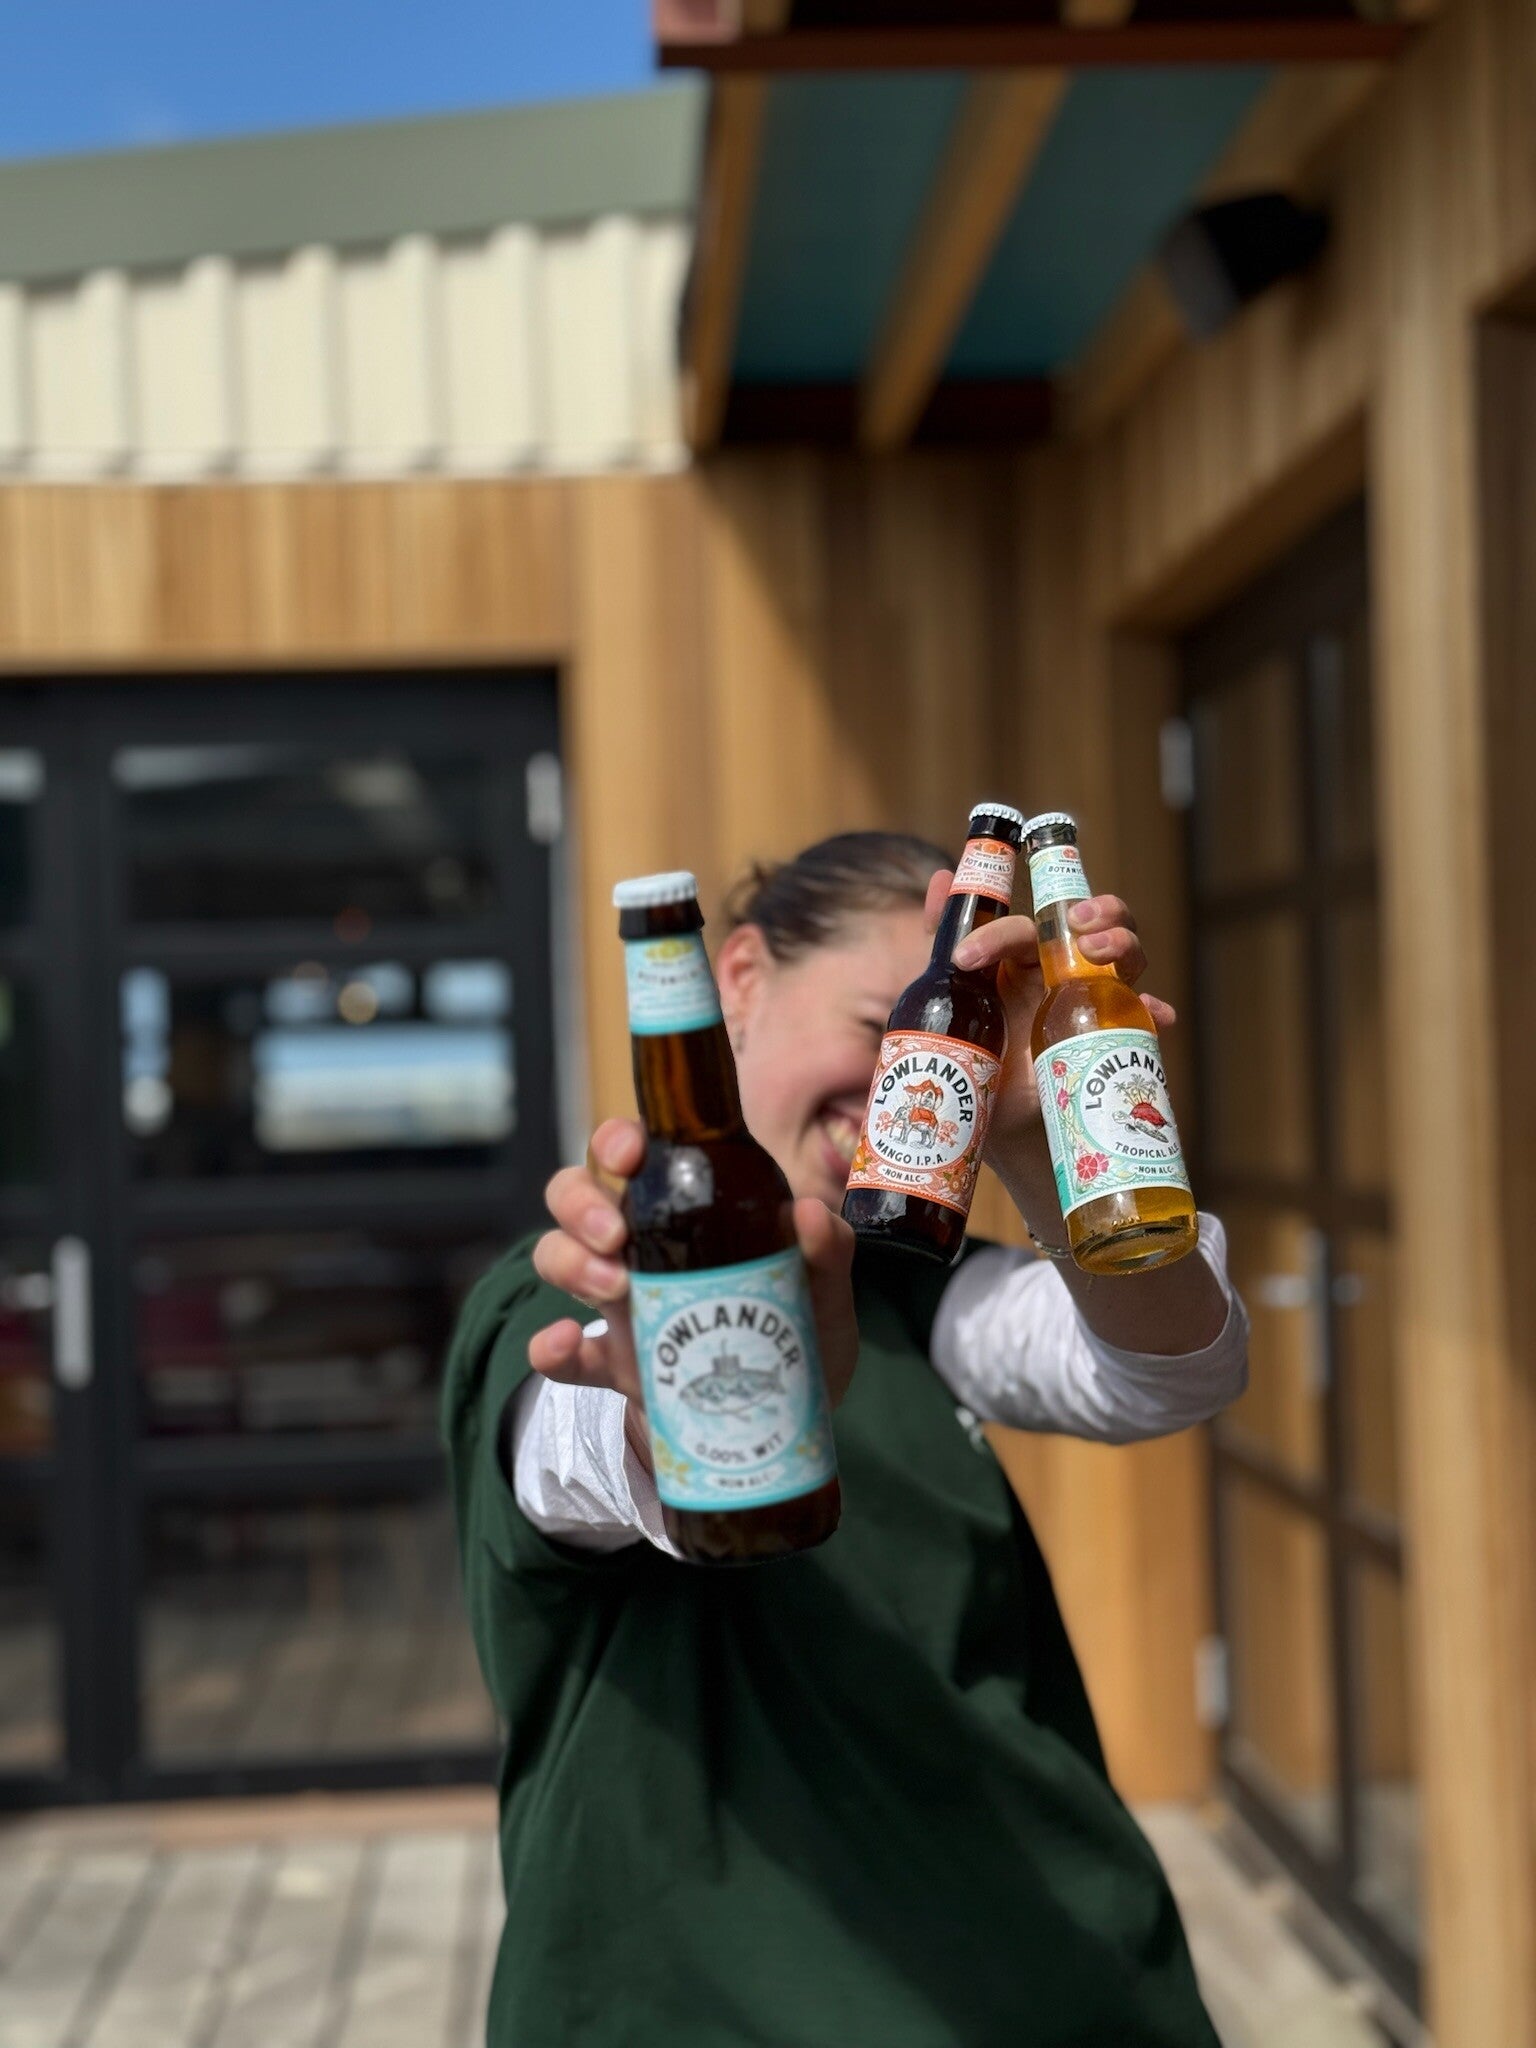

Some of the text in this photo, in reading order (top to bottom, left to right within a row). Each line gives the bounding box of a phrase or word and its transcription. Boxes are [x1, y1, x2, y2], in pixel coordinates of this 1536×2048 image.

[1085, 1051, 1167, 1110] LOWLAND
[875, 1139, 948, 1166] MANGO I.P.A.
[1115, 1141, 1180, 1158] TROPICAL ALE
[657, 1304, 800, 1387] LOWLANDER
[751, 1430, 783, 1459] WIT
